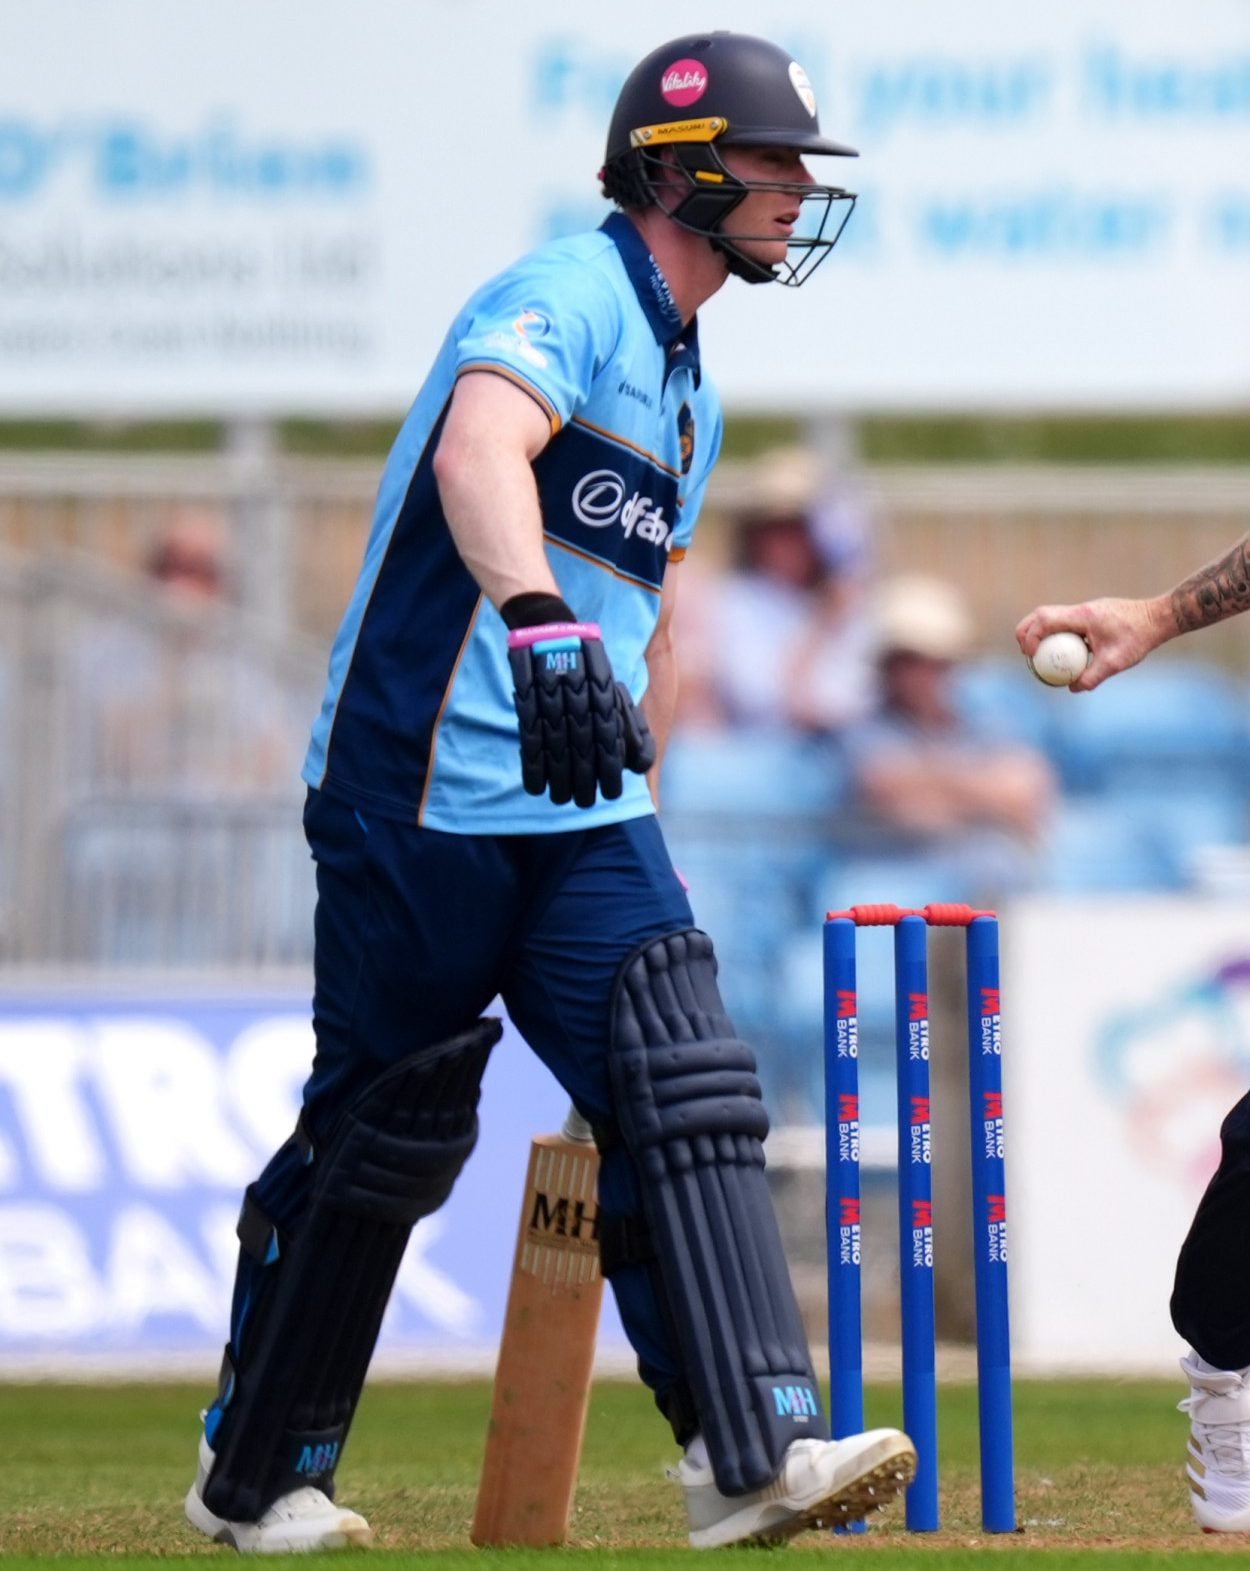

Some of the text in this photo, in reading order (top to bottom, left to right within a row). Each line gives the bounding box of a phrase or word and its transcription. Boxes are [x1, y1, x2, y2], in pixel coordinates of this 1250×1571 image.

[662, 71, 707, 92] Vitality
[857, 54, 1050, 134] your
[918, 184, 1172, 258] water
[837, 1019, 848, 1058] BANK
[909, 1021, 920, 1060] BANK
[981, 1017, 992, 1055] BANK
[839, 1123, 850, 1162] BANK
[911, 1125, 922, 1164] BANK
[984, 1120, 996, 1159] BANK
[840, 1226, 851, 1265] BANK
[912, 1228, 924, 1268] BANK
[987, 1223, 999, 1263] BANK
[772, 1386, 817, 1416] MH
[296, 1442, 338, 1472] MH
